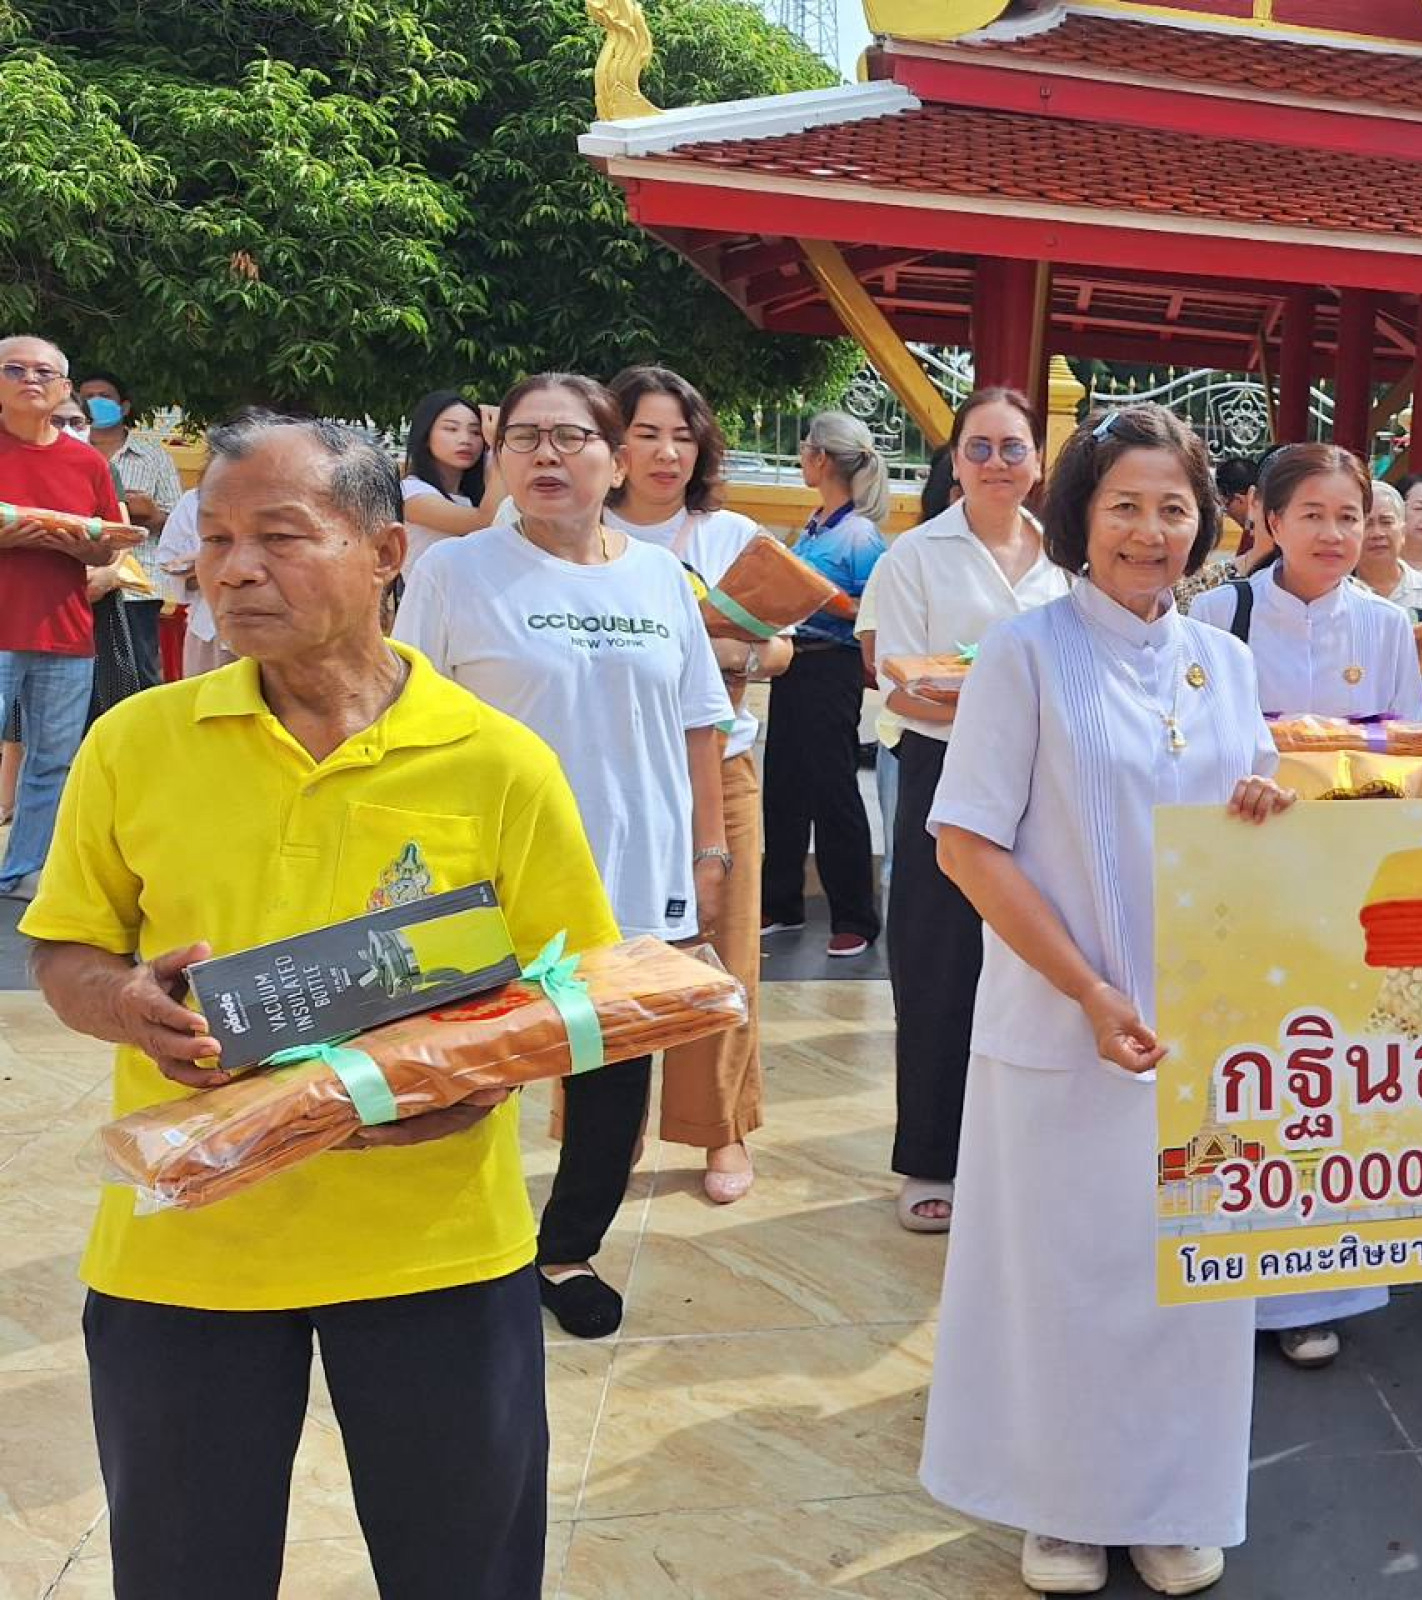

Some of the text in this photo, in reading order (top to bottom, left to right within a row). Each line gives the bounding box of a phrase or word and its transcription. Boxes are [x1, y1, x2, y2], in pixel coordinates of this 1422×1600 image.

[571, 637, 600, 648] NEW
[255, 972, 288, 1032] VACUUM
[275, 955, 315, 1033] INSULATED
[303, 965, 331, 1008] BOTTLE
[220, 992, 246, 1034] panda
[1180, 1246, 1243, 1284] โดย
